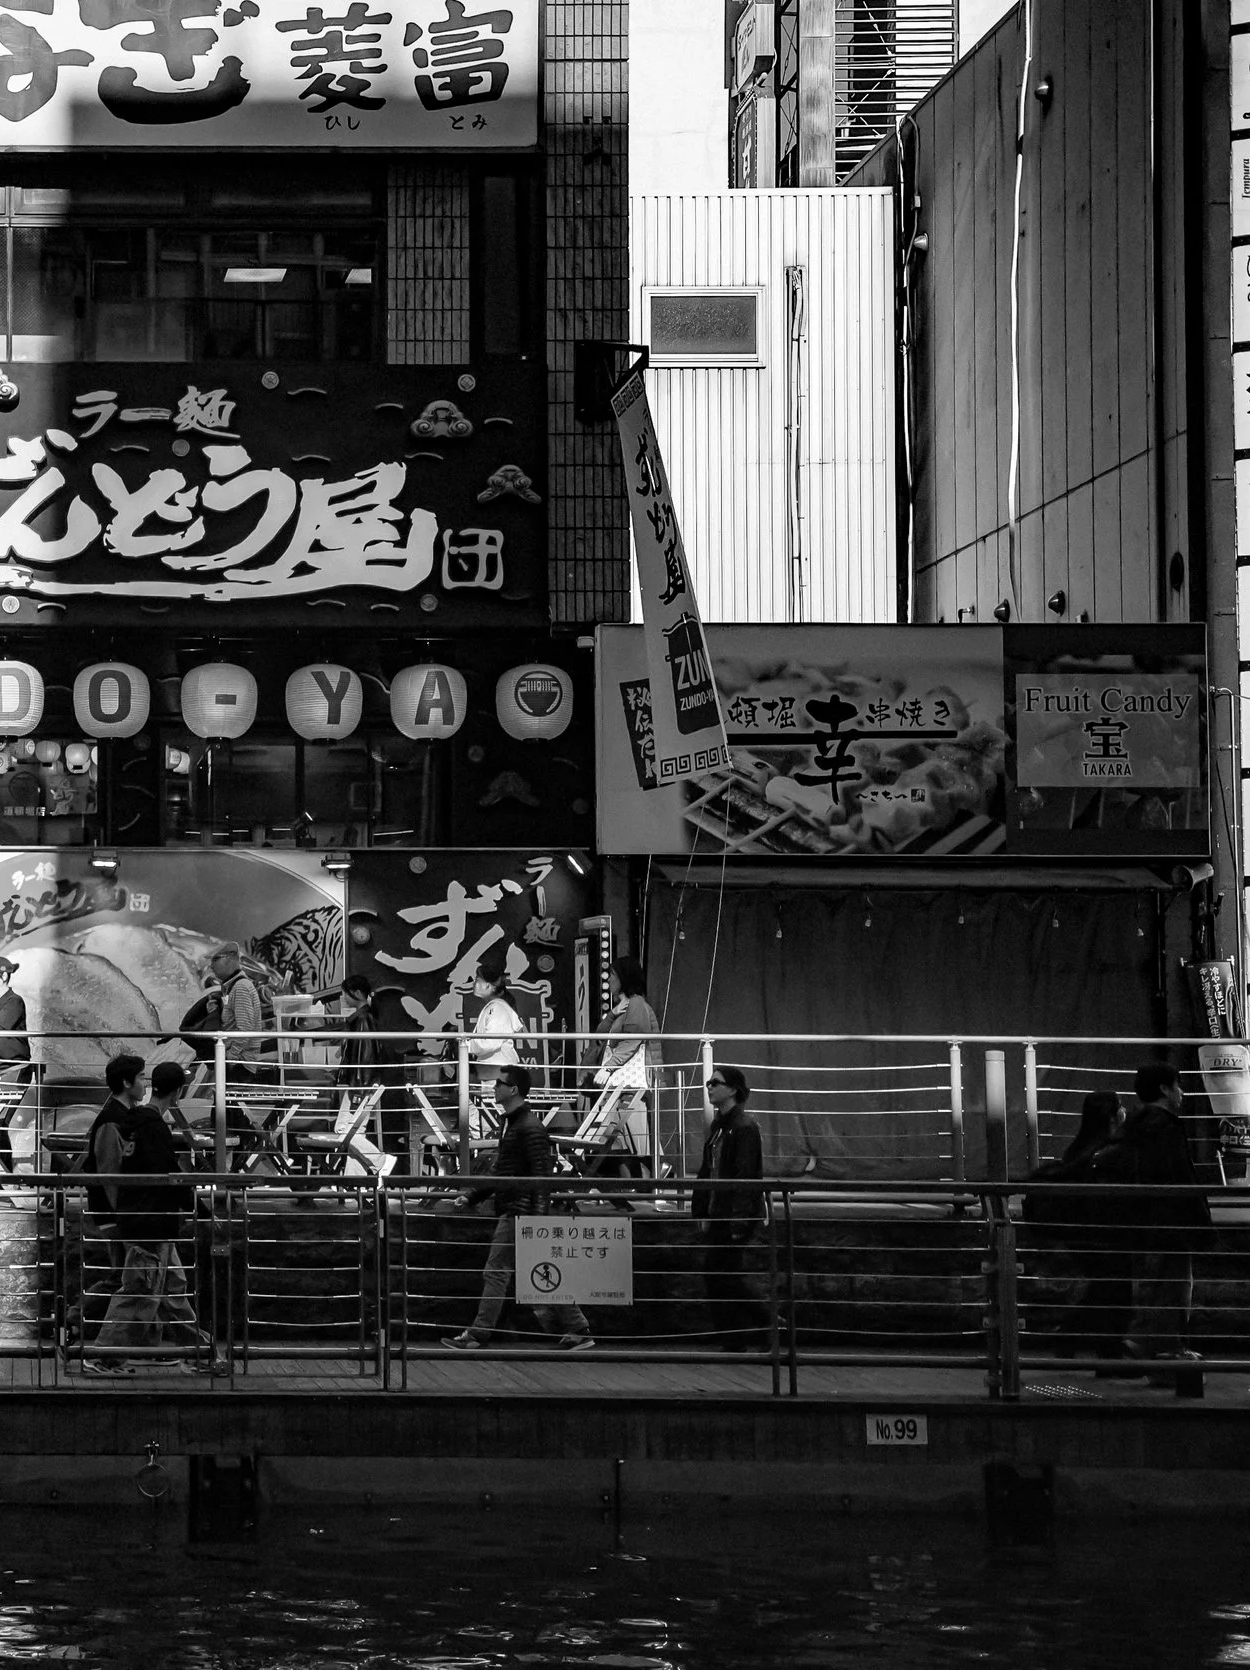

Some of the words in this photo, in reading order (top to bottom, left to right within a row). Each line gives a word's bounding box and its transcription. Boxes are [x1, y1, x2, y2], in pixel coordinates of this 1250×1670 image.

[324, 115, 361, 131] ひし
[449, 114, 488, 131] とみ
[72, 384, 241, 439] ラー麺
[1025, 687, 1092, 713] Fruit
[1100, 687, 1191, 719] Candy
[865, 697, 951, 728] 串焼き
[1084, 717, 1130, 759] 宝
[1083, 763, 1131, 776] TAKARA
[1213, 1058, 1238, 1066] DRY
[521, 1226, 627, 1240] 柵の乗り越えは
[551, 1246, 610, 1259] 禁止です
